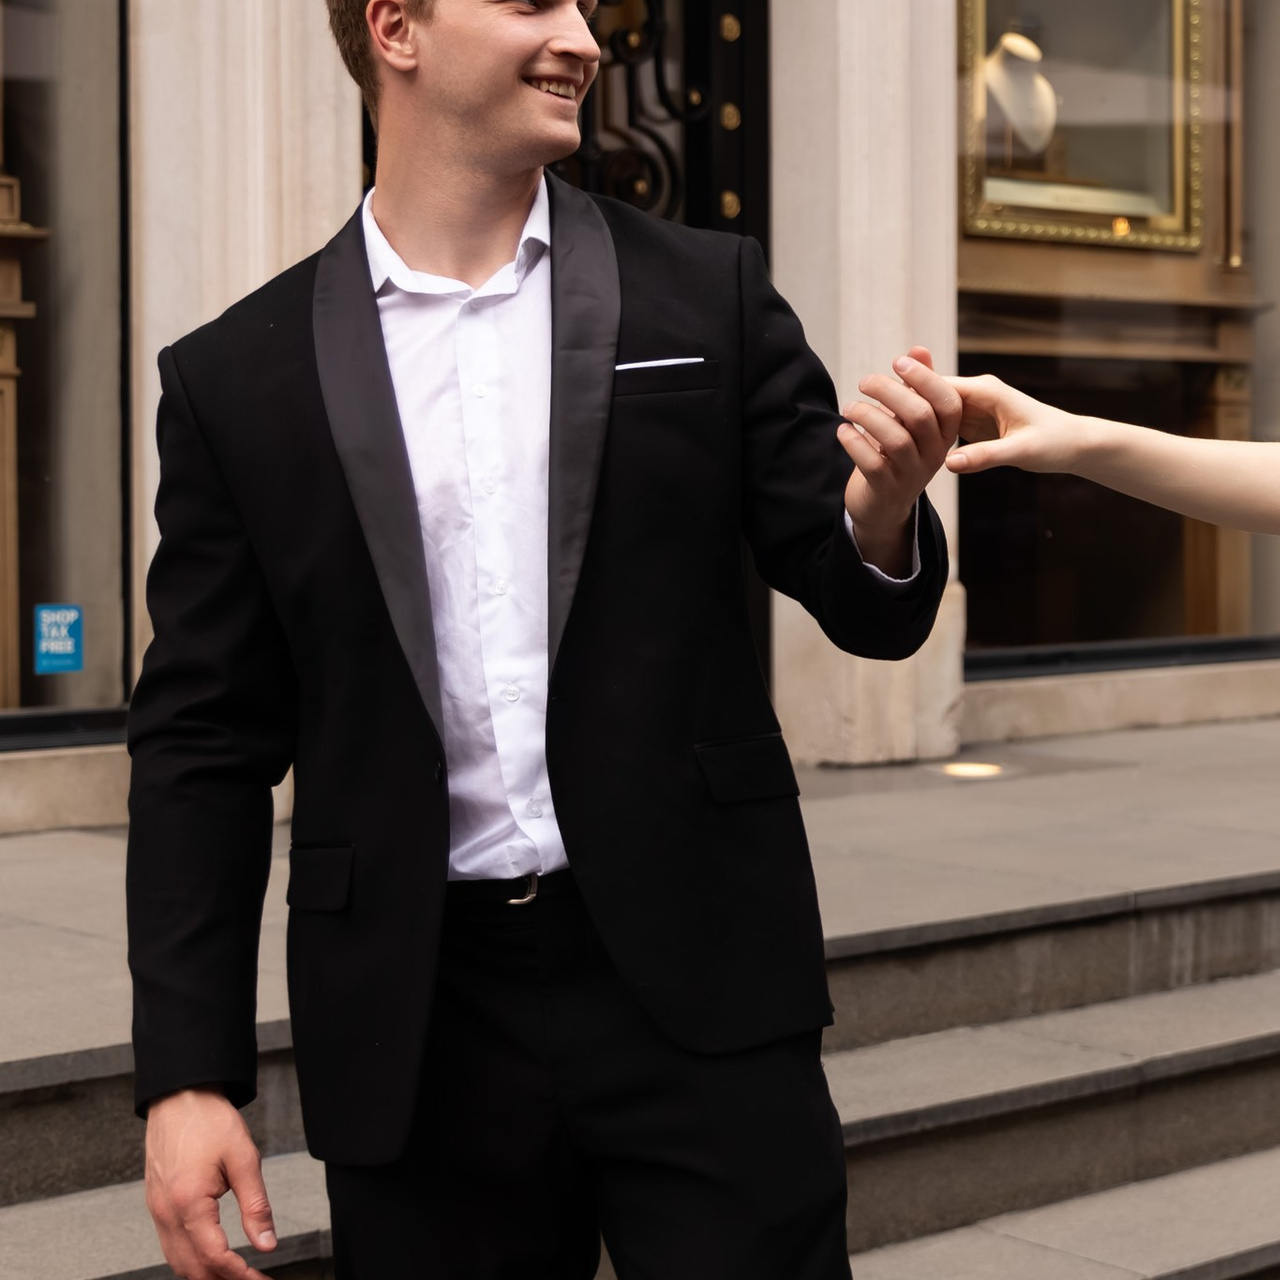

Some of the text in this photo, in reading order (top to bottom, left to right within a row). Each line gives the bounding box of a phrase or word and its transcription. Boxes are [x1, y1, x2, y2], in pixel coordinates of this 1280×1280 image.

[40, 609, 79, 624] SHOP
[41, 623, 69, 638] TAX
[40, 638, 75, 654] FREE
